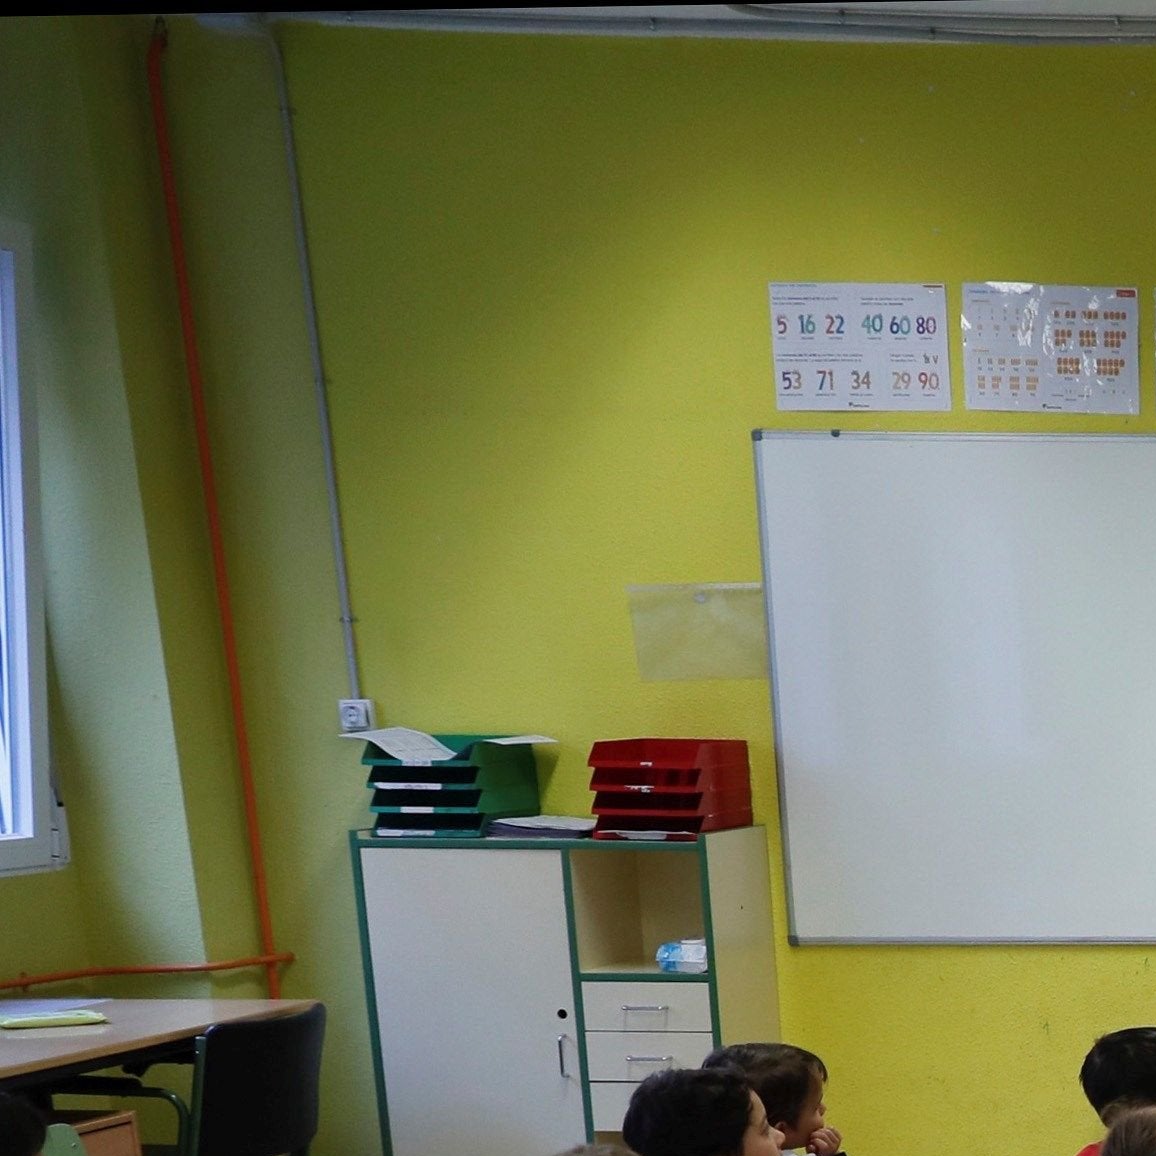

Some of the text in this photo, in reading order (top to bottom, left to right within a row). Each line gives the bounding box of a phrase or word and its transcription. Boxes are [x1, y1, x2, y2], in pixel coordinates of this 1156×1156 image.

[776, 314, 845, 334] 5 16 22
[861, 313, 937, 335] 40 60 80
[782, 370, 871, 391] 53 71 34
[892, 371, 940, 390] 29 90
